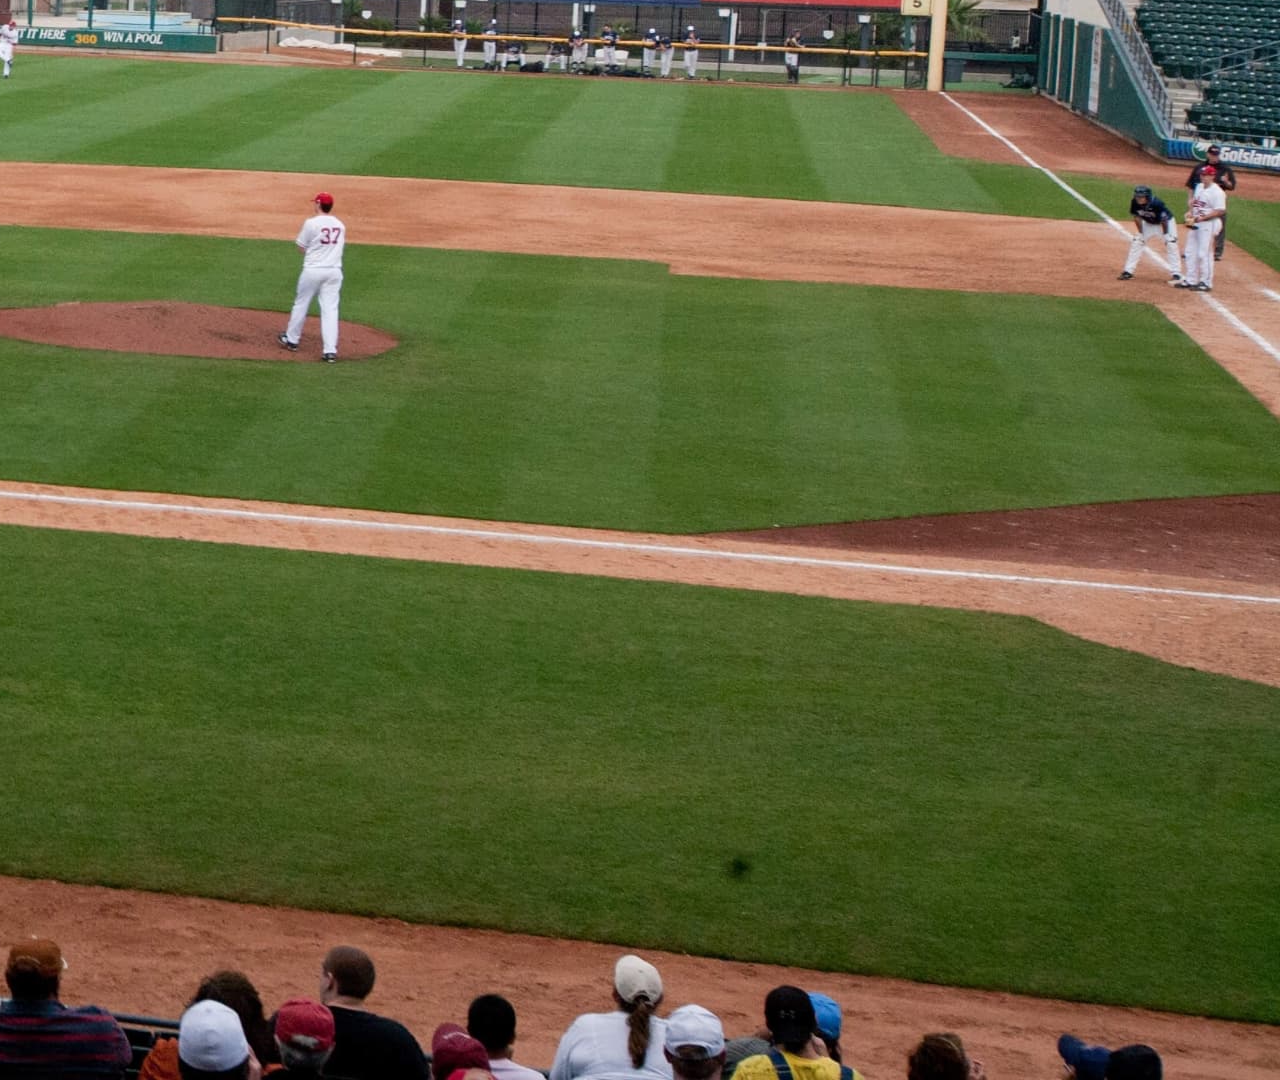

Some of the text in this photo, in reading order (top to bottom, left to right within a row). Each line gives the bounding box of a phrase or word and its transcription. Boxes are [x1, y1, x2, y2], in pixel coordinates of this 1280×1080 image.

[27, 28, 38, 39] IT
[39, 28, 67, 40] HERE
[75, 34, 97, 44] 360
[104, 32, 163, 44] WIN A POOL
[320, 227, 341, 244] 37
